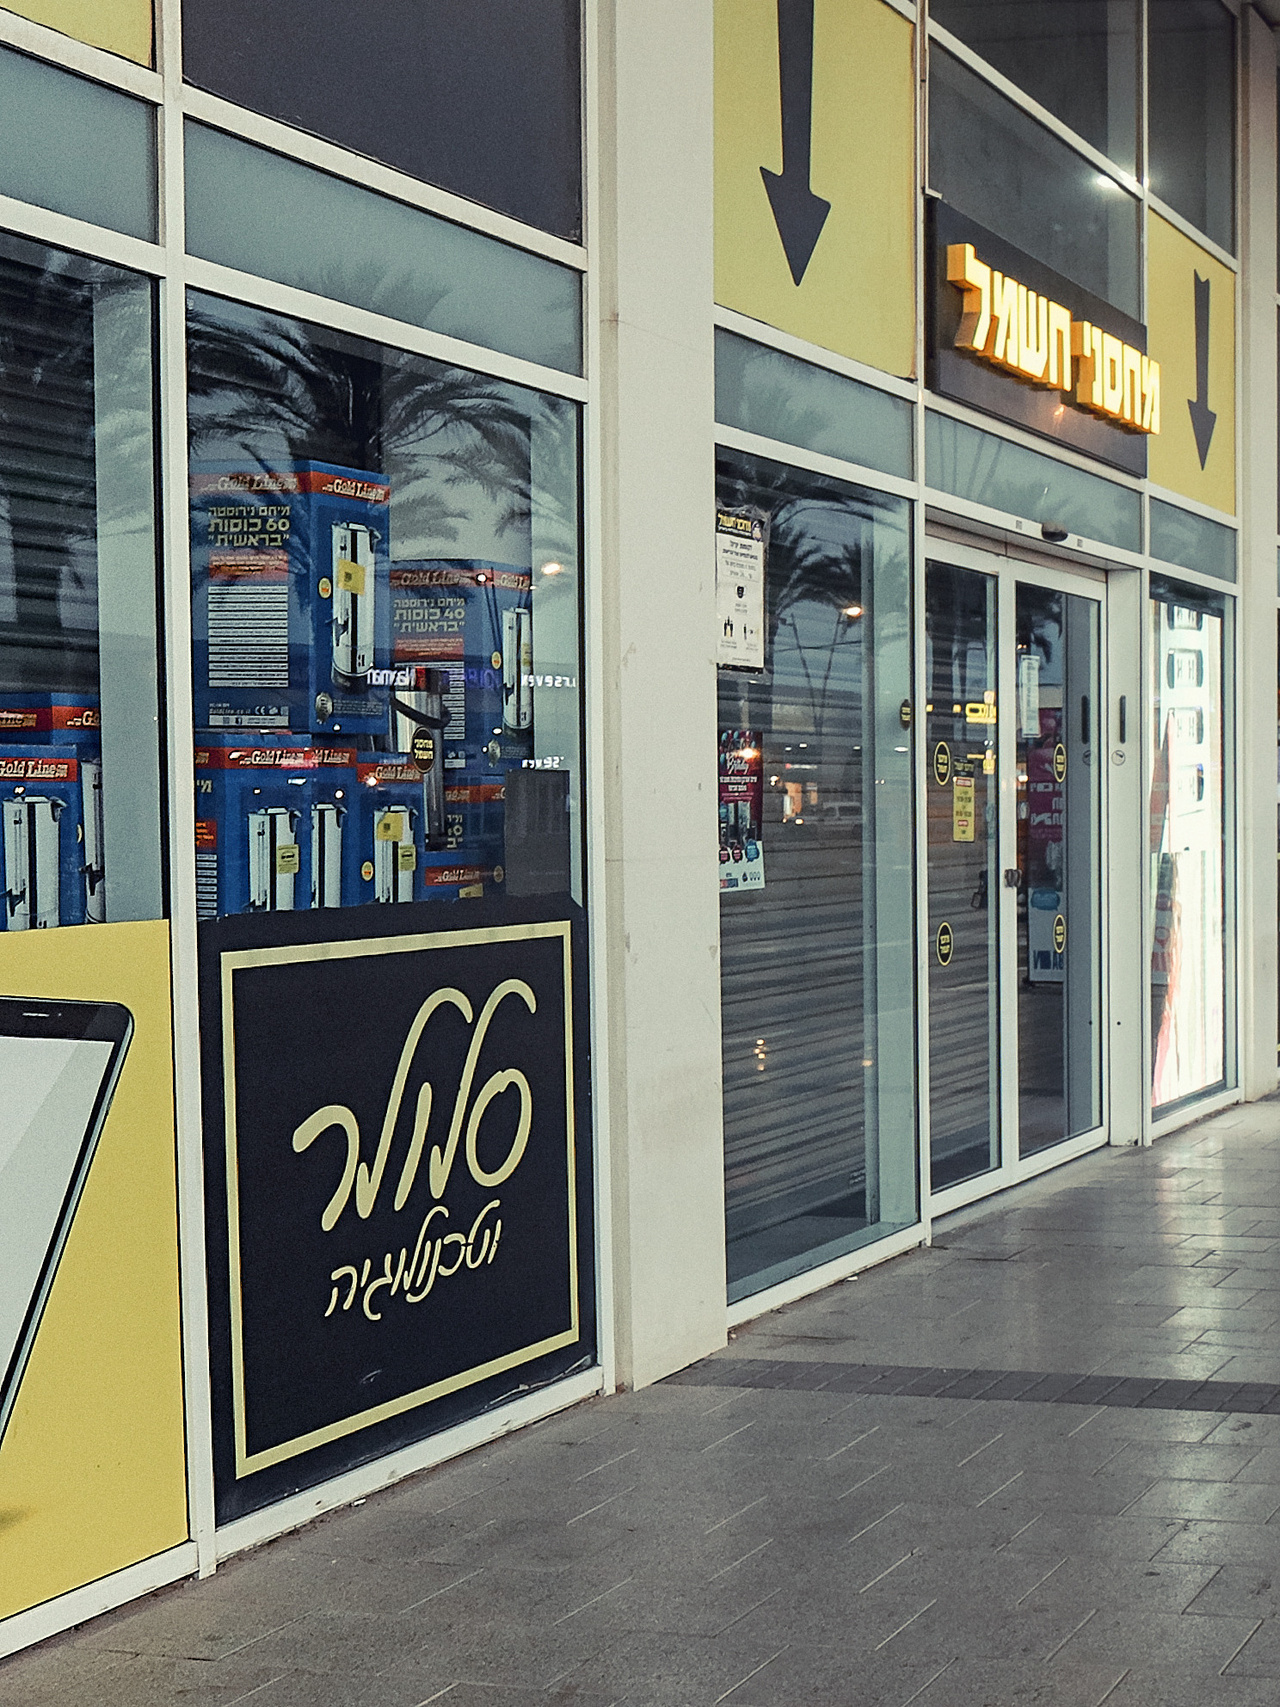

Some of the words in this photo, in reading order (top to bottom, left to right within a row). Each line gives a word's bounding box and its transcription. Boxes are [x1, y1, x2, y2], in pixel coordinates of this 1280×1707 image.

[948, 243, 1073, 392] חשמל
[1074, 320, 1161, 435] מחסני
[333, 479, 356, 495] Gold
[208, 518, 262, 533] כוסות
[265, 518, 290, 532] 60
[393, 608, 441, 620] כוסות
[443, 608, 465, 619] 40
[251, 750, 274, 764] Gold
[26, 759, 57, 778] Line
[375, 766, 398, 780] Gold
[442, 868, 459, 882] Gold
[292, 978, 538, 1232] סלולר
[324, 1199, 502, 1321] וטכנולוגיה
